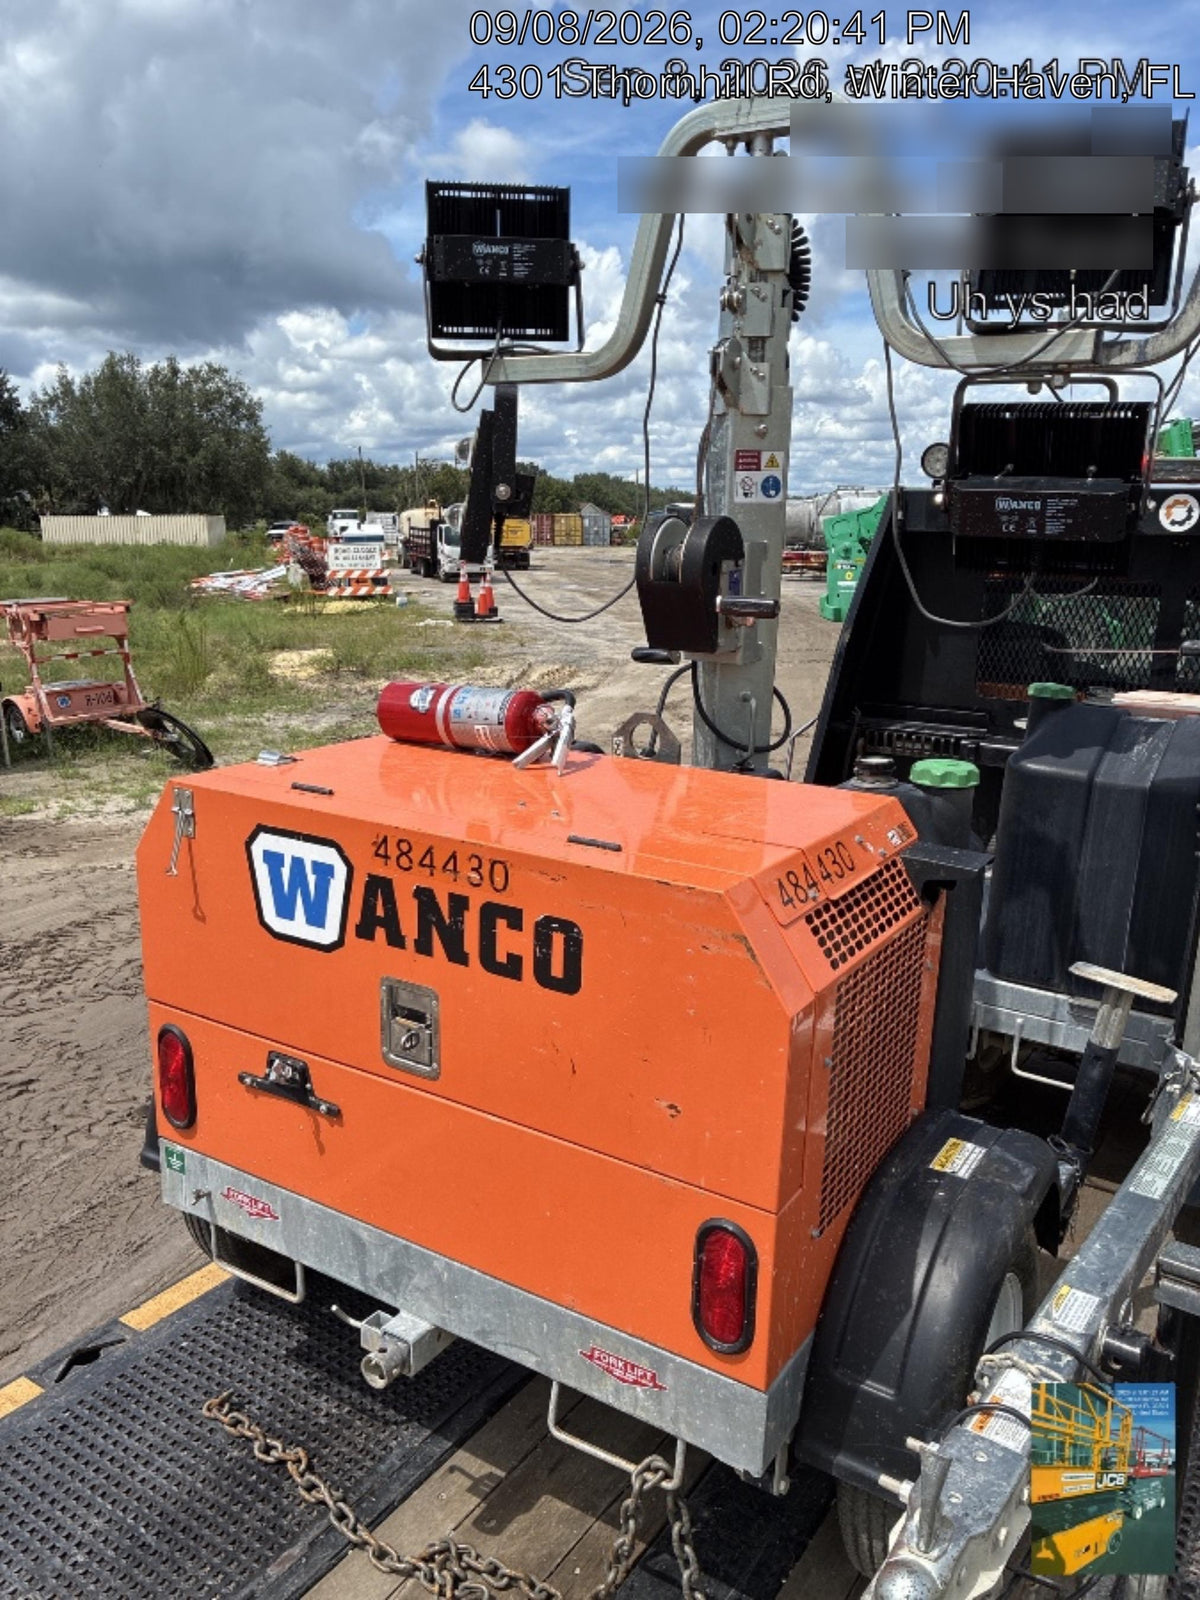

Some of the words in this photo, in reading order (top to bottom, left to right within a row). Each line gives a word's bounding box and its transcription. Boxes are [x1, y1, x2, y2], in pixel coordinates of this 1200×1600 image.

[373, 833, 510, 893] 484430
[777, 841, 855, 909] 484430
[262, 849, 584, 996] WANCO
[594, 1350, 625, 1369] FORK
